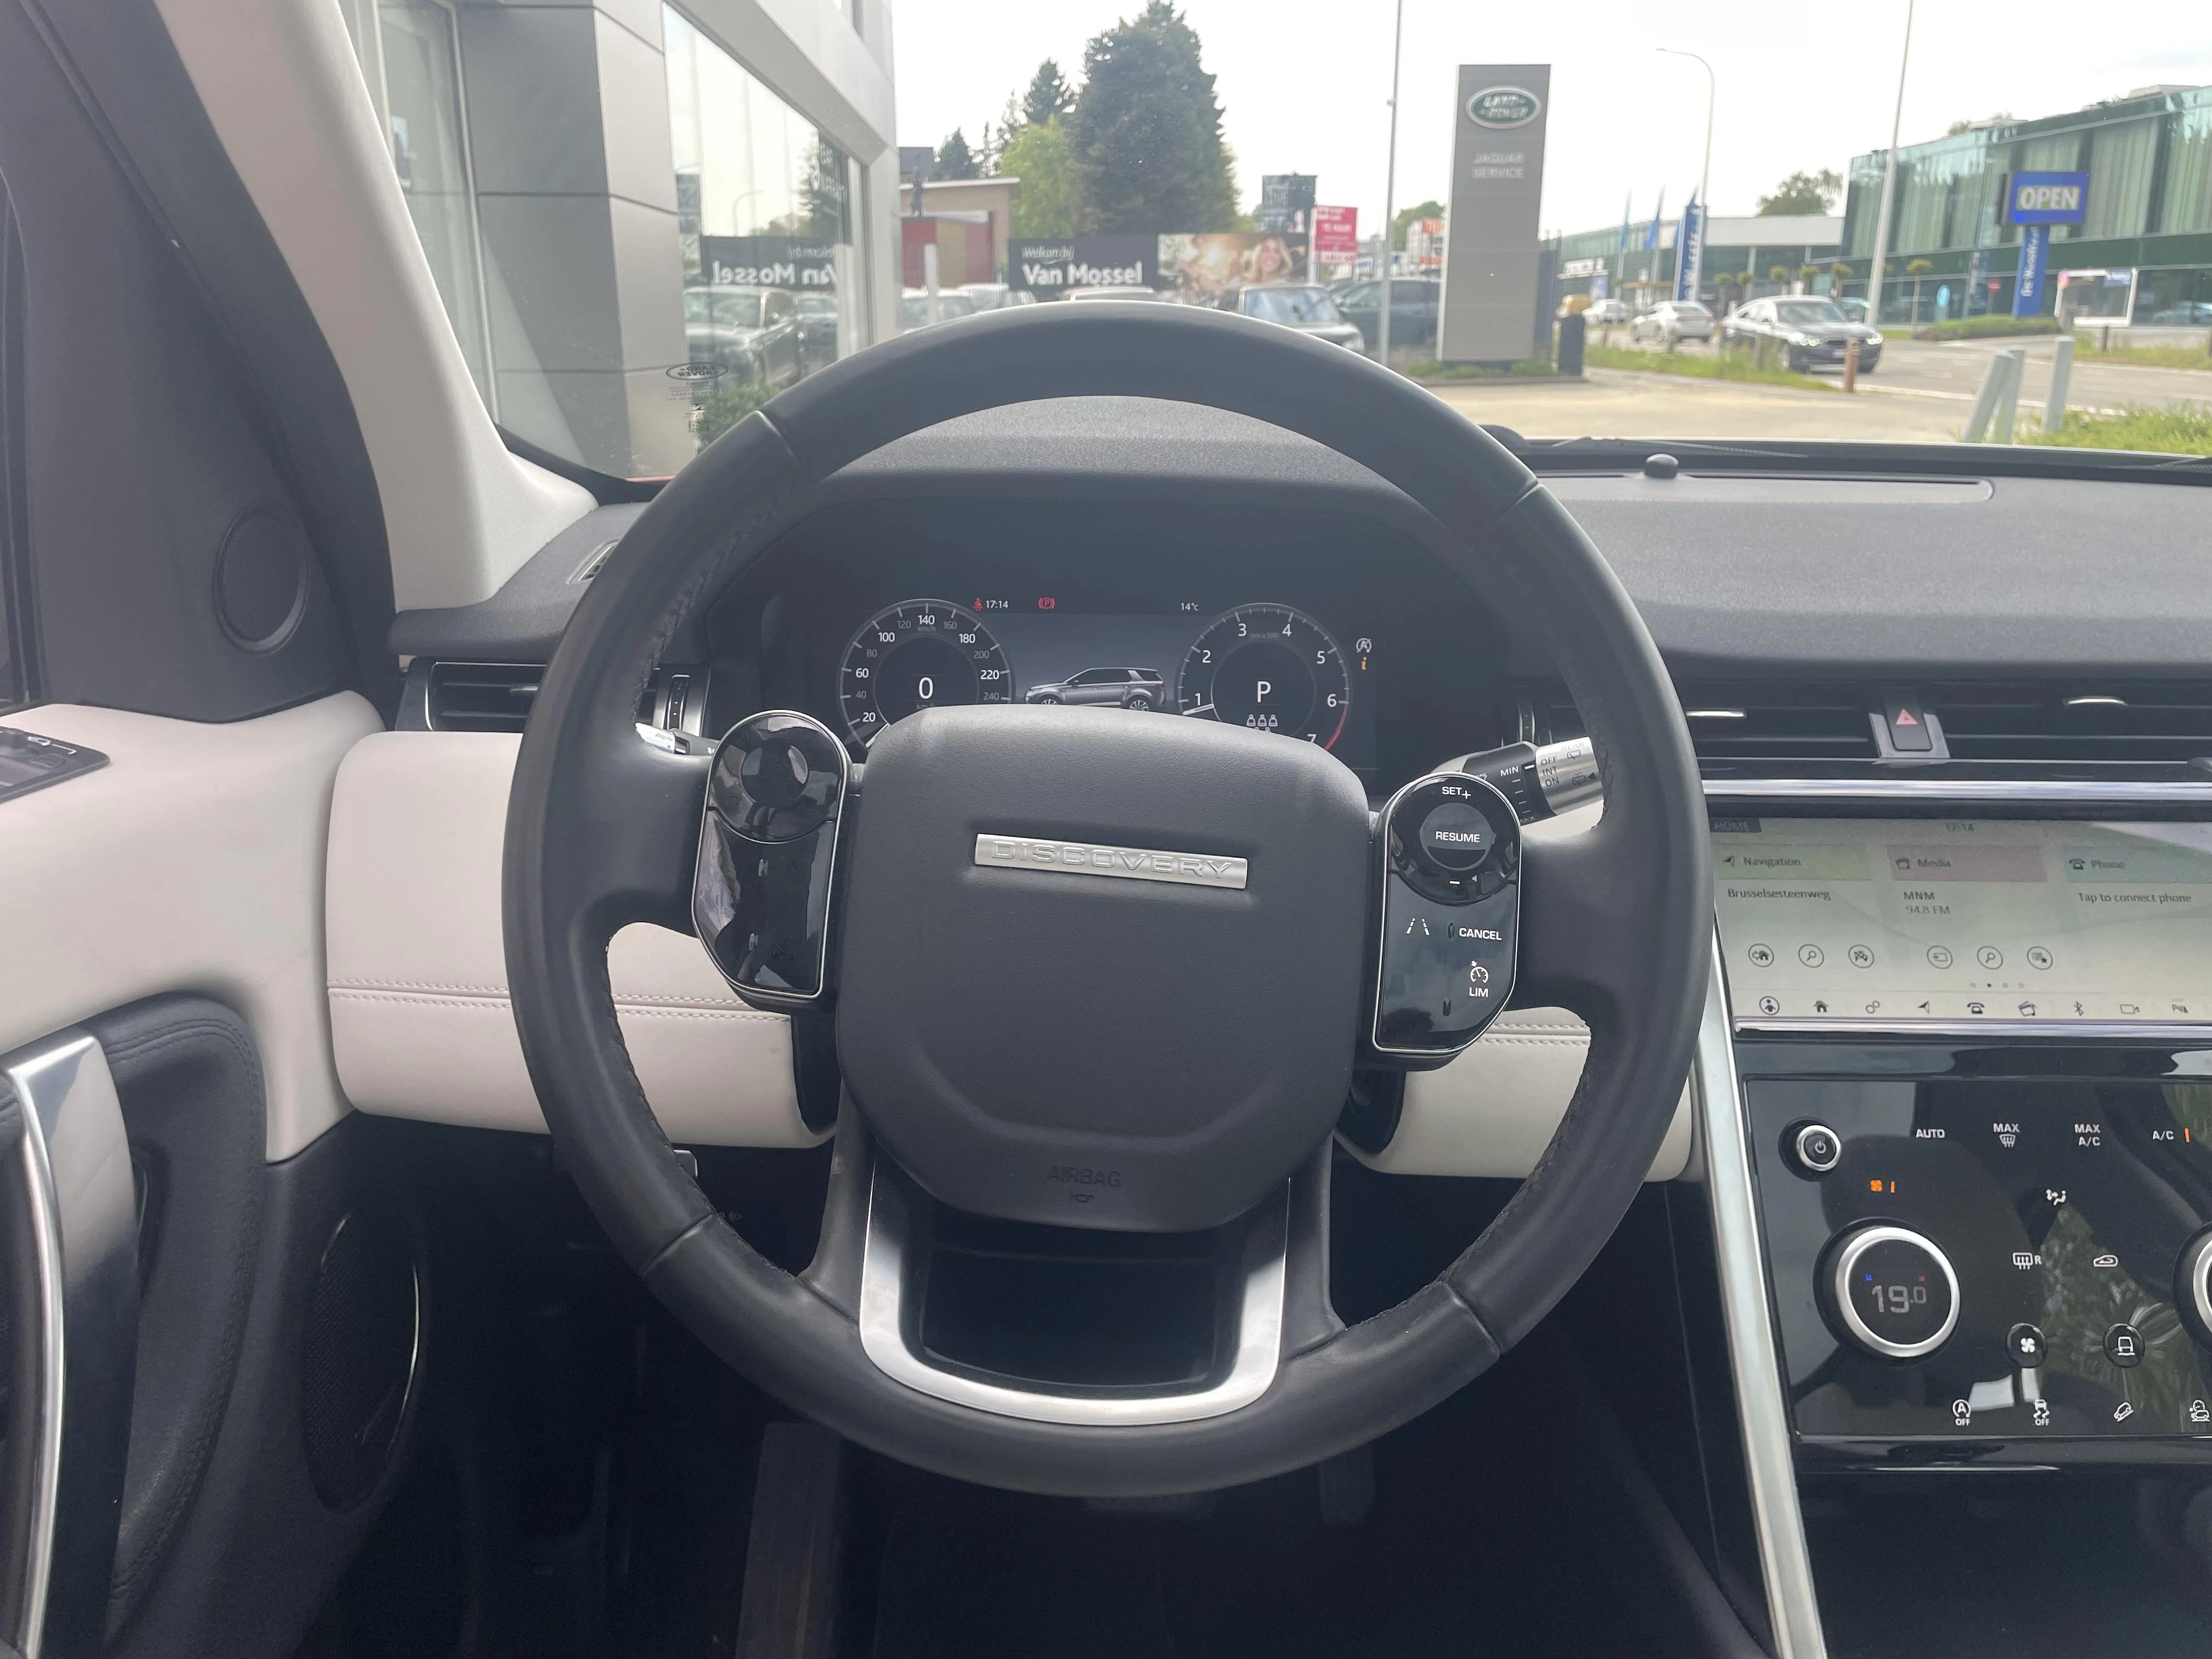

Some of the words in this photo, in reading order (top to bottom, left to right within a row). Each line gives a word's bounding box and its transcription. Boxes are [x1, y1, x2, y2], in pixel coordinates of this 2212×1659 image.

[1472, 151, 1525, 165] JAGUAR
[1471, 166, 1525, 179] SERVICE
[2019, 187, 2079, 210] OPEN
[1022, 262, 1063, 286] Van
[1066, 259, 1143, 285] Mossel
[986, 600, 1009, 608] 17:14
[898, 620, 911, 629] 120
[918, 614, 935, 625] 140
[943, 621, 957, 629] 160
[1238, 623, 1247, 637] 3
[1282, 623, 1293, 636] 4
[878, 632, 895, 642] 100
[958, 633, 976, 644] 180
[866, 649, 877, 658] 80
[973, 651, 990, 659] 200
[1201, 650, 1211, 663] 2
[1317, 651, 1325, 664] 5
[855, 668, 870, 679] 60
[980, 669, 1000, 680] 220
[918, 676, 934, 699] 0
[1257, 681, 1271, 703] P
[855, 691, 867, 699] 40
[983, 692, 1000, 701] 240
[1195, 693, 1201, 706] 1
[1327, 693, 1337, 708] 6
[862, 712, 876, 723] 20
[1307, 733, 1317, 743] 7
[1561, 741, 1585, 752] REAR
[1541, 755, 1558, 766] OFF
[1500, 765, 1520, 777] MIN
[1542, 766, 1558, 776] INT
[1544, 776, 1560, 787] ON
[1436, 831, 1480, 843] RESUME
[992, 840, 1233, 879] DISCOVERY
[1743, 857, 1802, 868] Navigation
[1917, 858, 1952, 868] Media
[2090, 860, 2125, 869] Phone
[1727, 888, 1832, 901] Brusselsesteenweg
[1904, 891, 1936, 900] MNM
[2078, 893, 2097, 903] Tap
[2159, 894, 2193, 904] phone
[1905, 906, 1929, 915] 94.8
[1933, 906, 1951, 915] FM
[1458, 927, 1502, 941] CANCEL
[1469, 986, 1489, 998] LIM
[1915, 1128, 1946, 1139] AUTO
[1993, 1123, 2020, 1133] MAX
[2074, 1124, 2101, 1133] MAX
[2152, 1131, 2175, 1141] A/C
[2078, 1137, 2101, 1147] A/C
[1046, 1165, 1122, 1188] AIRBAG
[2034, 1256, 2042, 1265] R
[1872, 1285, 1927, 1313] 19.0
[1955, 1418, 1971, 1426] OFF
